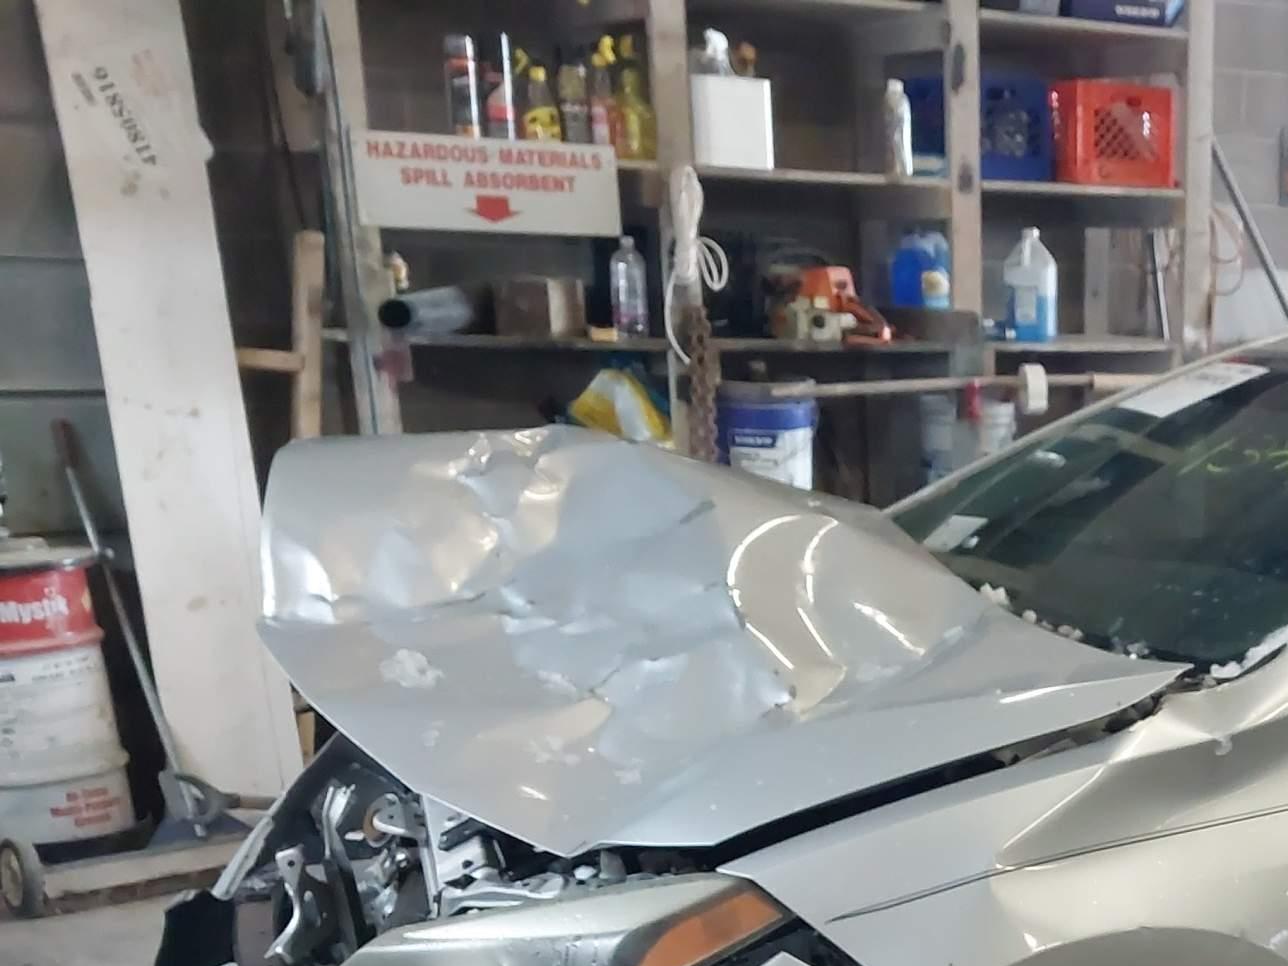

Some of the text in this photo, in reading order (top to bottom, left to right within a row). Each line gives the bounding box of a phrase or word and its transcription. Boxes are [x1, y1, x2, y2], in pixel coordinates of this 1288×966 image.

[366, 140, 603, 169] HAZARDOUS MATERIALS
[400, 167, 577, 193] SPILL ABSORBENT
